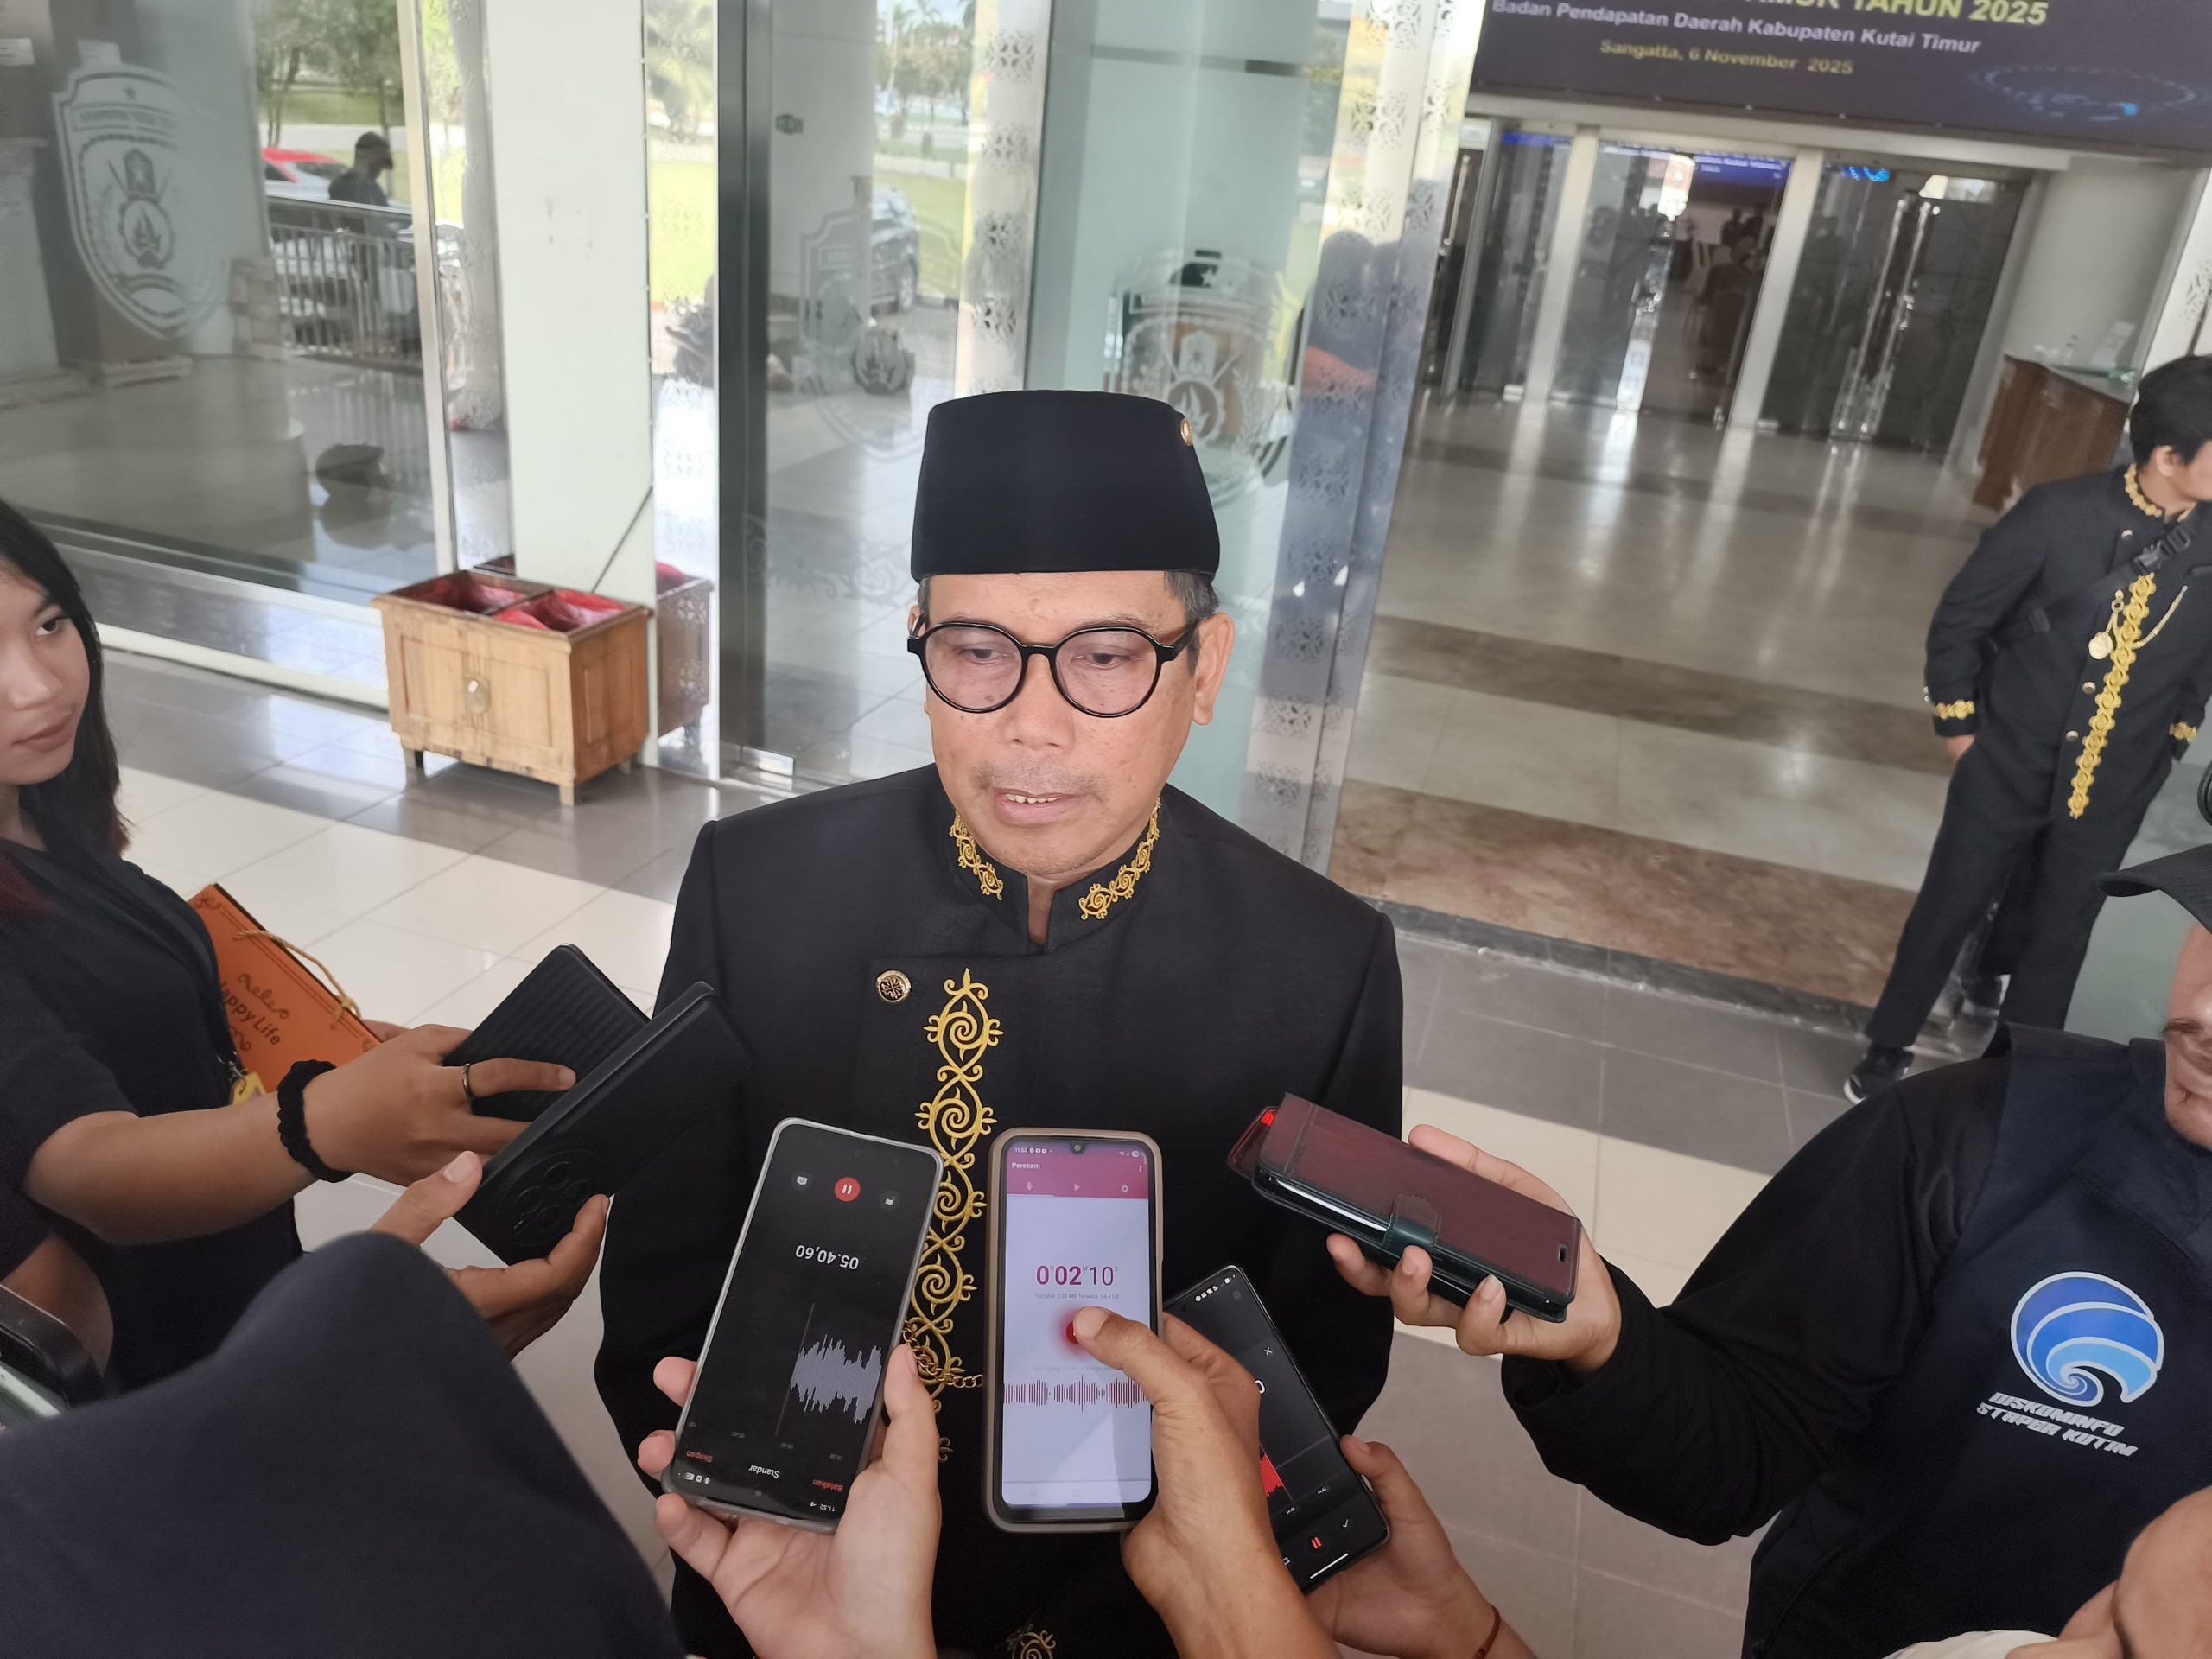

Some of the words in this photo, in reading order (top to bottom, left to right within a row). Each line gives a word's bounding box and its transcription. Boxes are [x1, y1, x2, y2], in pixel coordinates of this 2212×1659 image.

[1491, 0, 1552, 17] Badan
[1556, 2, 1669, 27] Pendapatan
[1673, 12, 1743, 34] Daerah
[1747, 18, 1855, 42] Kabupaten
[1860, 28, 1915, 48] Kutai
[1920, 32, 1981, 54] Timur
[1853, 0, 1962, 19] TAHUN
[1968, 0, 2049, 25] 2025
[1600, 39, 1684, 61] Sangatta,
[1688, 48, 1700, 61] 6
[1704, 48, 1798, 69] November
[1808, 56, 1853, 75] 2025
[221, 982, 257, 1022] appy
[253, 1016, 281, 1045] Life
[1011, 1161, 1041, 1170] Perekam
[796, 1245, 859, 1270] 05.40,60
[1988, 1392, 2125, 1437] DISKOMINFO
[2062, 1428, 2139, 1457] KUTIM
[748, 1465, 780, 1478] Standar
